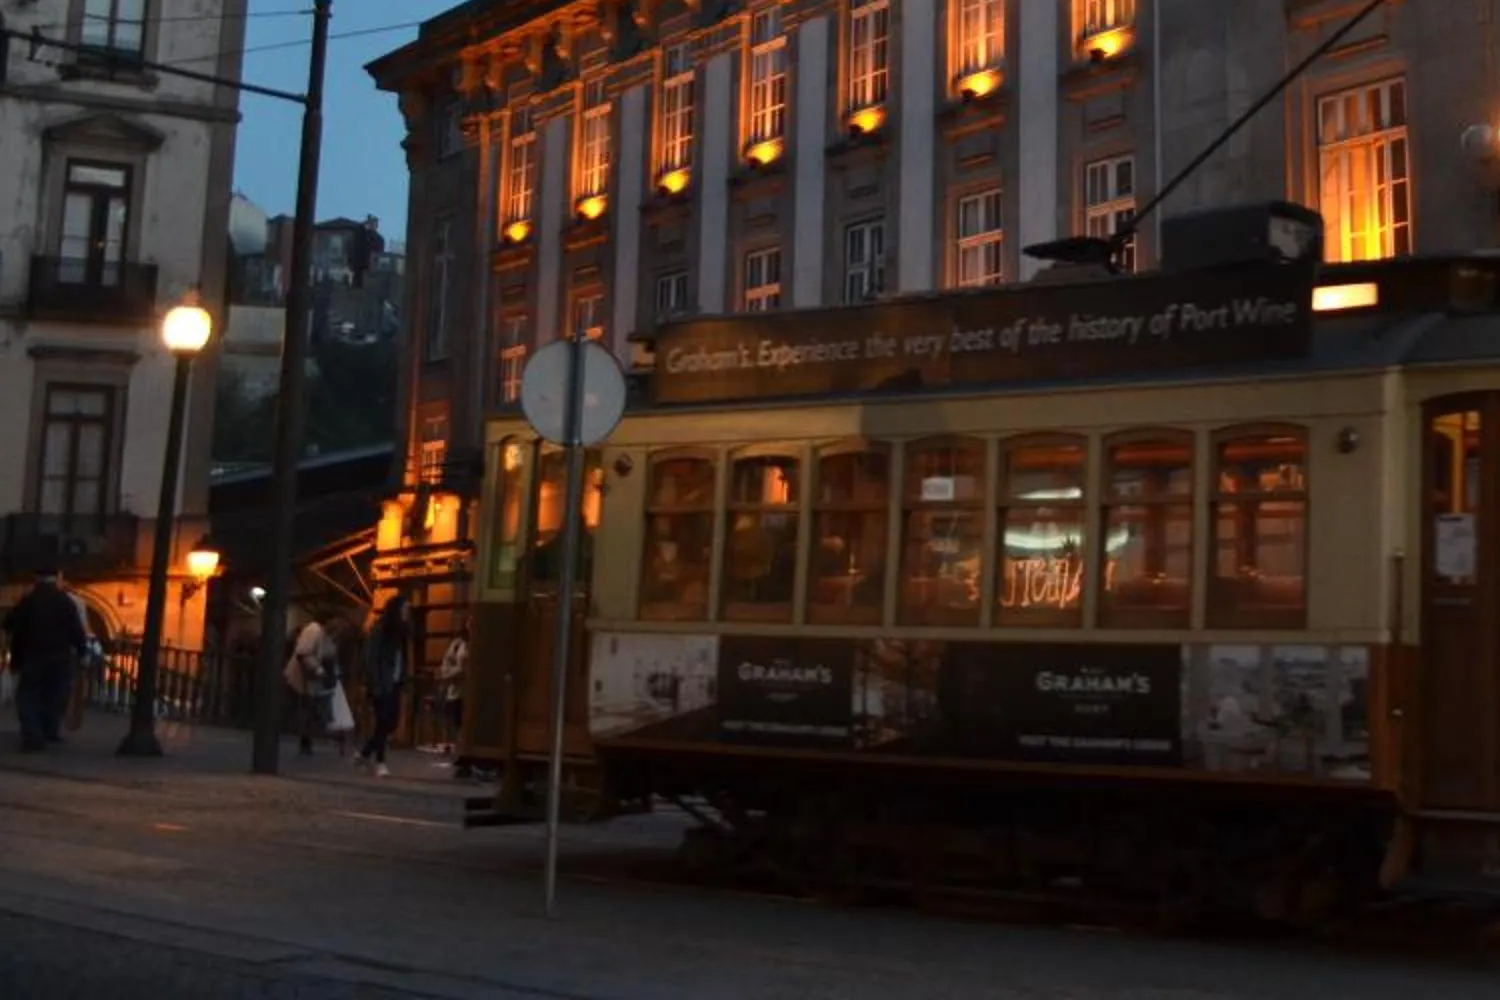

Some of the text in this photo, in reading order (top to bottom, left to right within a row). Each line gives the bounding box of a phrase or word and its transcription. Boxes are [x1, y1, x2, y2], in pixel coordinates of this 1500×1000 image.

[757, 338, 858, 371] Experience
[864, 331, 895, 358] the
[904, 334, 947, 362] very
[949, 325, 994, 352] best
[1000, 318, 1027, 352] of
[1028, 318, 1062, 345] the
[1068, 312, 1146, 346] history
[1149, 303, 1179, 338] of
[1180, 303, 1230, 331] Port
[1231, 296, 1297, 326] Wine
[737, 661, 833, 685] GRAHAM'S
[1035, 670, 1152, 694] GRAHAM'S
